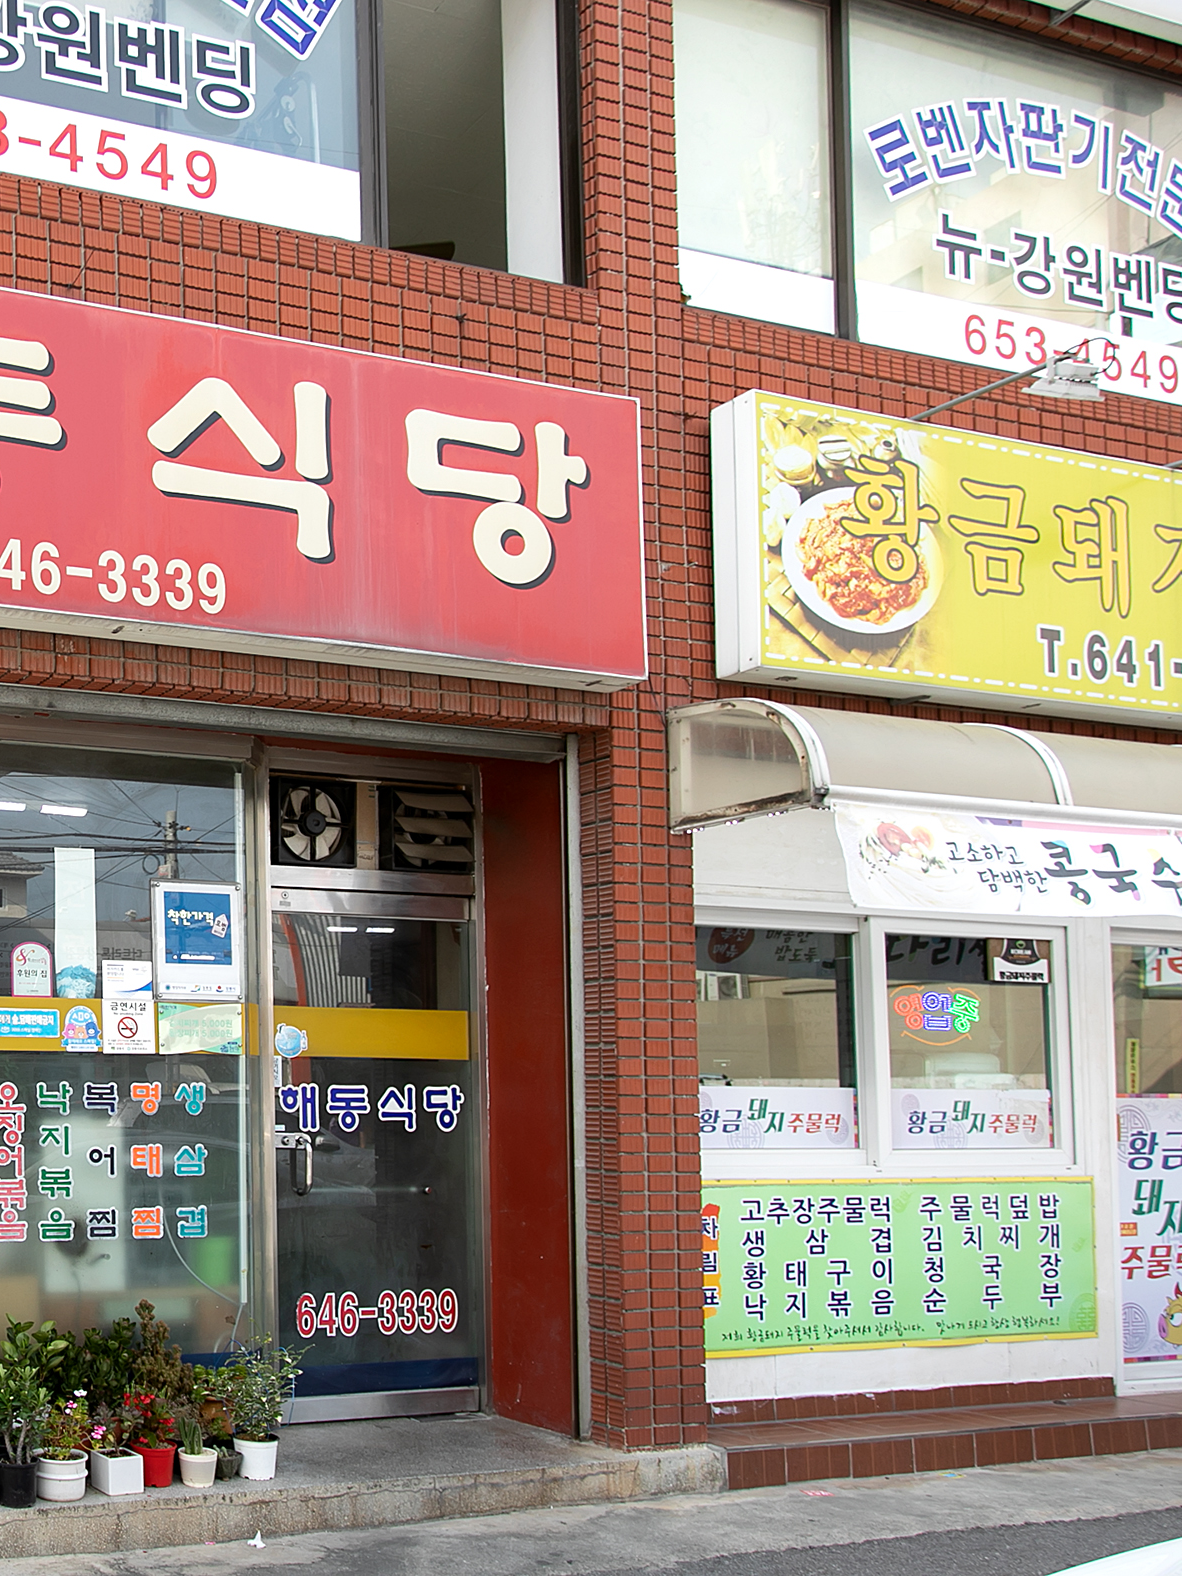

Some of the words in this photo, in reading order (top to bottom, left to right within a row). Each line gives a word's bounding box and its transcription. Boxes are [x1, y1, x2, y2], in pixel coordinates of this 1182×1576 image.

[964, 314, 1179, 394] 653-4549
[946, 840, 1025, 866] 고소하고
[977, 869, 1048, 894] 담백한
[167, 908, 214, 927] 착한가격
[17, 969, 38, 978] 후원의
[41, 969, 48, 979] 집
[110, 1002, 146, 1012] 금연시설
[893, 991, 981, 1034] 영업중
[279, 1083, 464, 1133] 해동식당
[787, 1111, 842, 1135] 주물럭
[907, 1099, 986, 1136] 황금돼지
[987, 1113, 1038, 1136] 주물럭
[36, 1080, 75, 1244] 낙지볶음
[83, 1080, 119, 1241] 복어찜
[129, 1080, 165, 1241] 명태찜
[173, 1079, 209, 1240] 생삼겹
[740, 1194, 894, 1225] 고추장주물럭
[919, 1193, 1061, 1223] 주물럭덮밥
[741, 1226, 894, 1259] 생삼겹
[921, 1223, 1061, 1256] 김치찌개
[742, 1257, 895, 1290] 황태구이
[922, 1253, 1061, 1284] 청국장
[1120, 1244, 1182, 1281] 주물
[296, 1288, 458, 1339] 646-3339
[743, 1288, 895, 1321] 낙지볶음
[922, 1282, 1063, 1315] 순두부
[722, 1330, 743, 1342] 저희
[990, 1316, 1010, 1329] 항상
